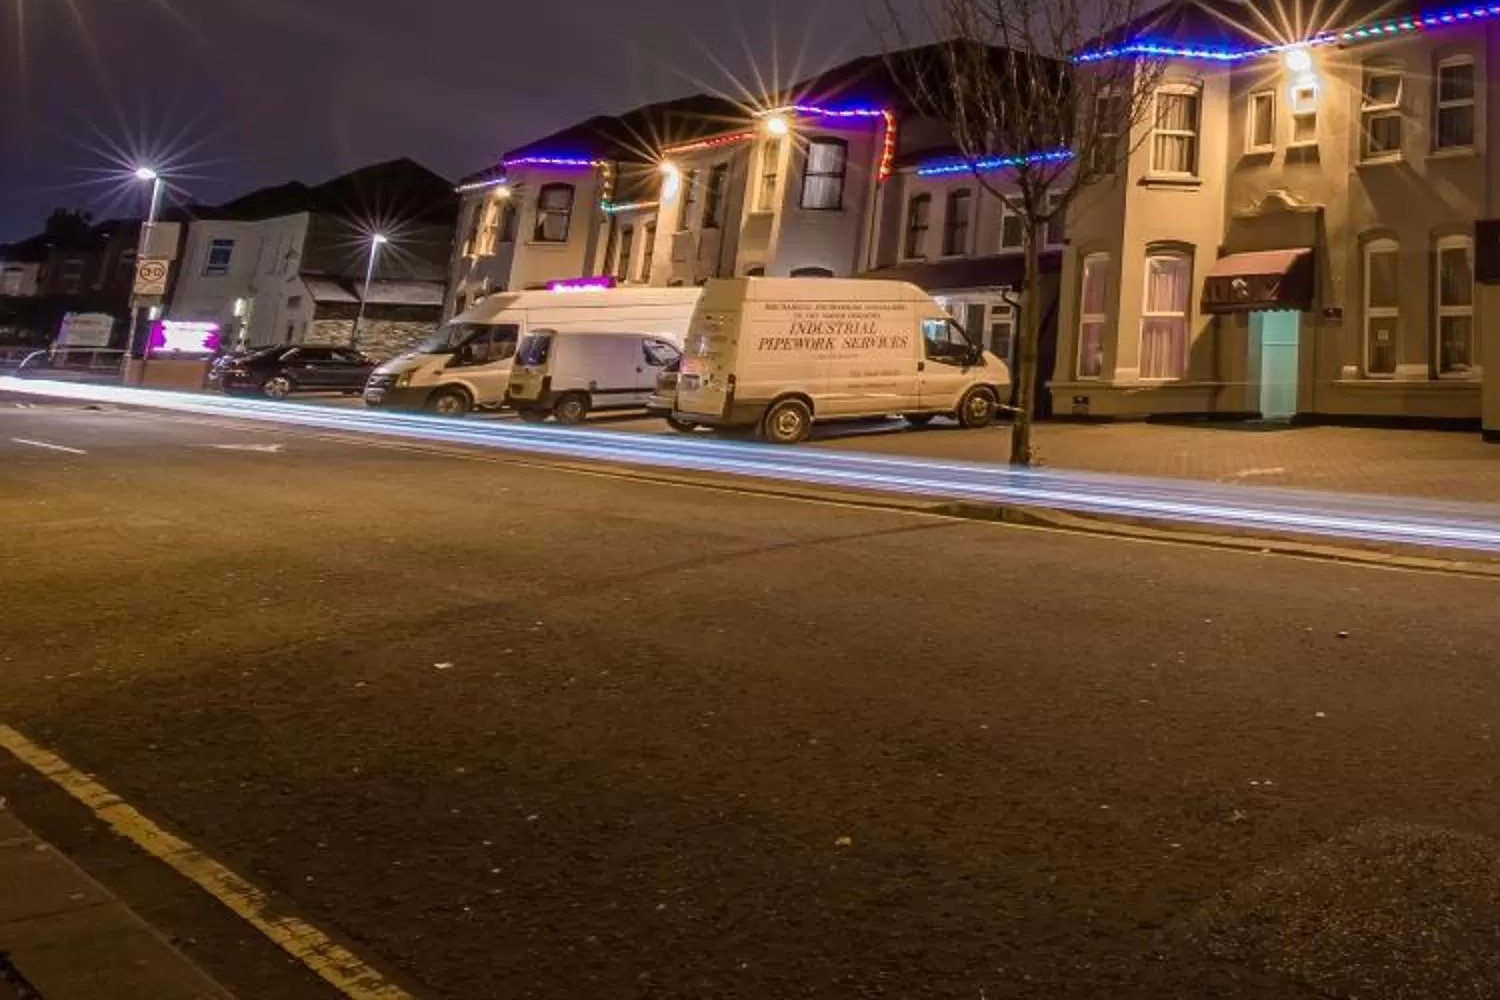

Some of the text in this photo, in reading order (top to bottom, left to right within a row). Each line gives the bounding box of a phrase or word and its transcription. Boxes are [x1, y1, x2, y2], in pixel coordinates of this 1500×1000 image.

[789, 321, 877, 335] INDUSTRIAL
[757, 336, 909, 351] PIPEWORK SERVICES
